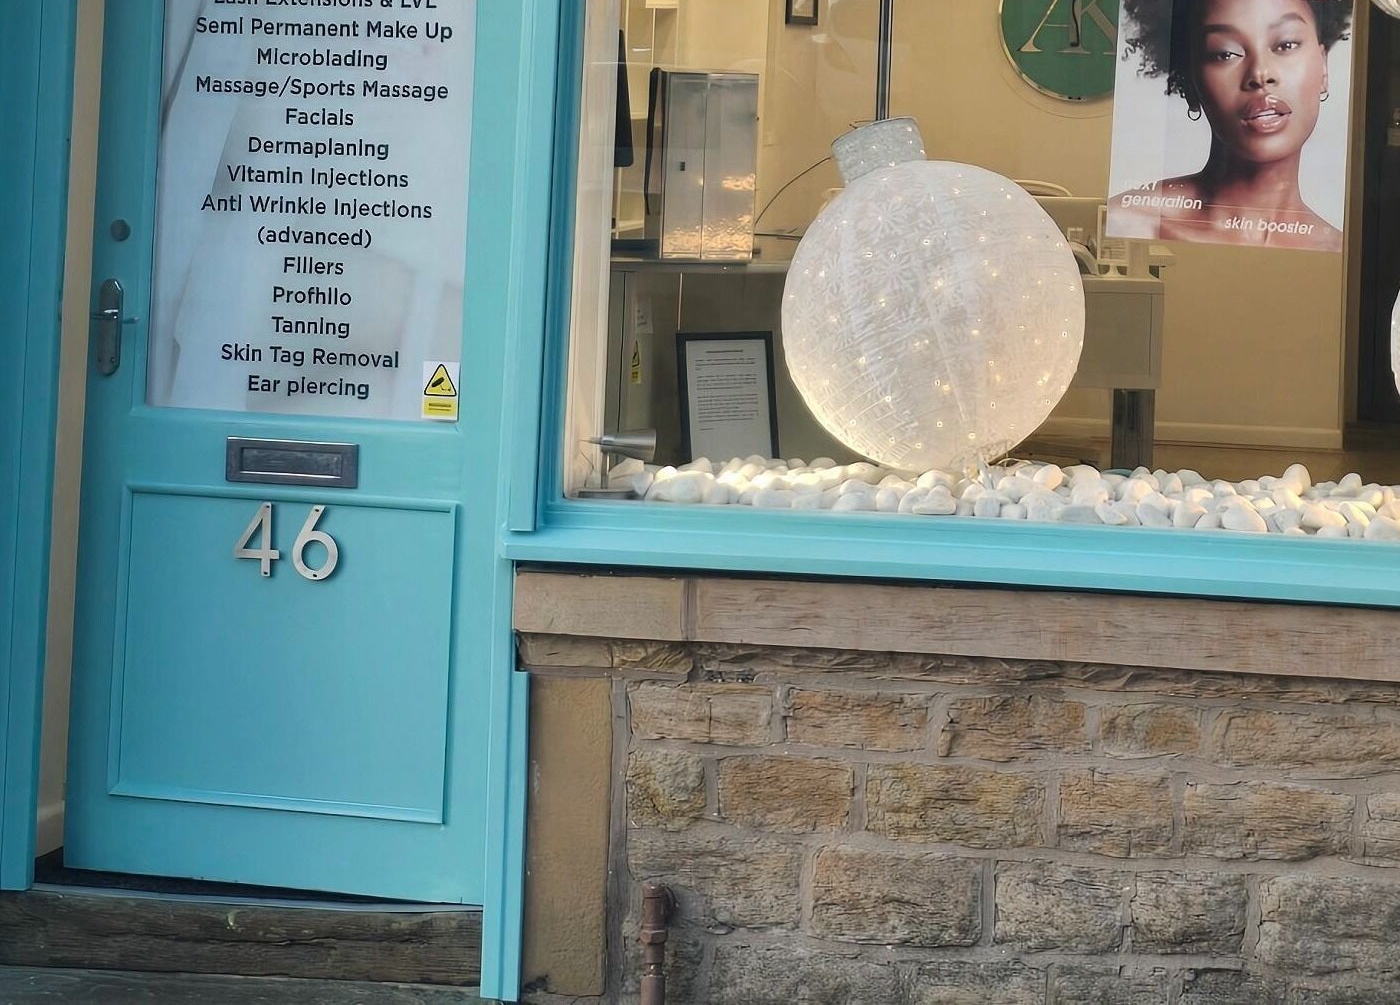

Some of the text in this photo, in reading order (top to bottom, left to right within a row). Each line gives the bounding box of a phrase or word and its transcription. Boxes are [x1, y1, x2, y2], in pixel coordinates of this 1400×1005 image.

[196, 17, 453, 42] Semi Permanent Make Up
[257, 48, 388, 70] Microblading
[196, 76, 449, 102] Massage/Sports Massage
[285, 108, 354, 126] Facials
[248, 136, 390, 160] Dermaplaning
[227, 164, 409, 188] Vitamin Injections
[200, 194, 432, 219] Anti Wrinkle Injections
[1121, 192, 1202, 210] generation
[257, 225, 372, 248] (advanced)
[1224, 216, 1314, 235] skin booster
[283, 256, 344, 275] Fillers
[273, 285, 352, 306] Profhilo
[271, 316, 350, 338] Tanning
[221, 343, 400, 369] Skin Tag Removal
[248, 374, 370, 400] Ear piercing
[234, 501, 339, 581] 46
